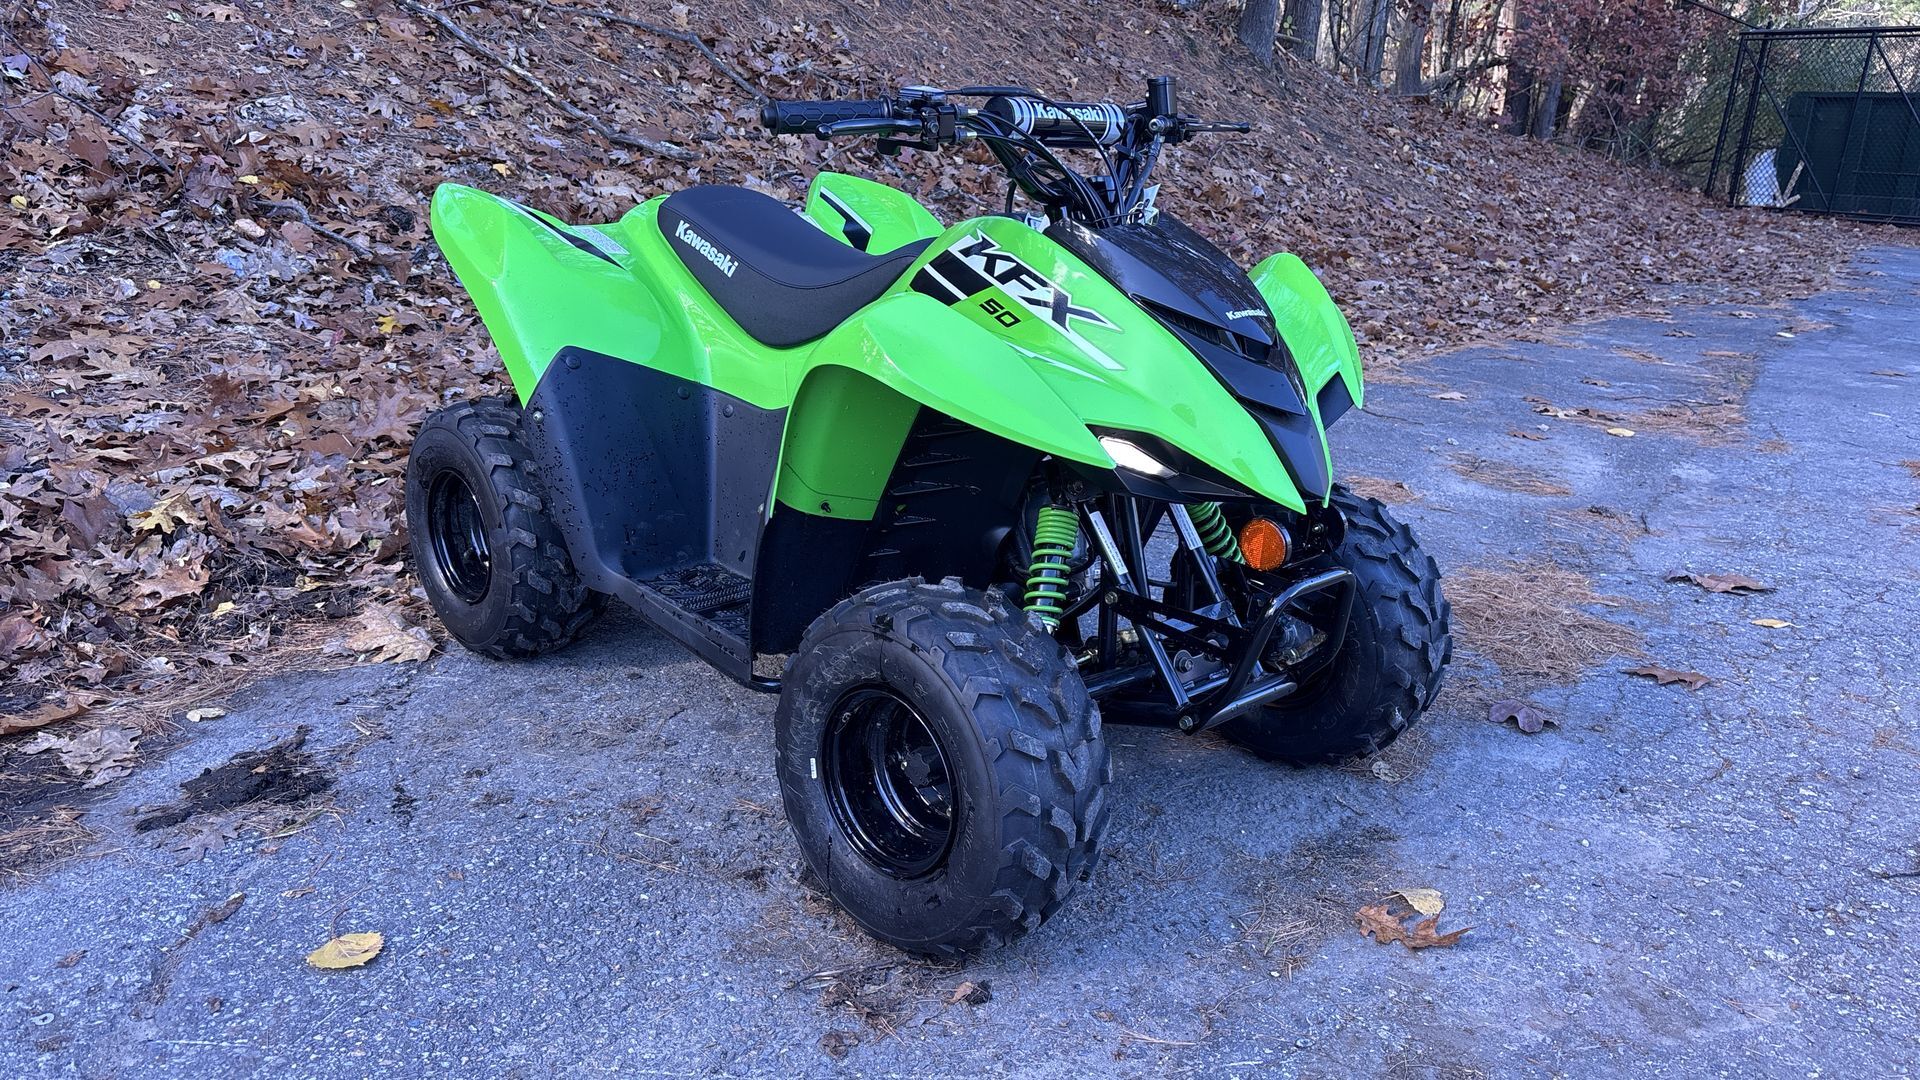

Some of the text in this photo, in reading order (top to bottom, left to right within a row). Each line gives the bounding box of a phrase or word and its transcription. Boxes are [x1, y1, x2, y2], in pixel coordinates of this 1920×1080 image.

[675, 220, 739, 278] Kawasaki
[955, 233, 1111, 334] KFX
[979, 298, 1022, 328] 50
